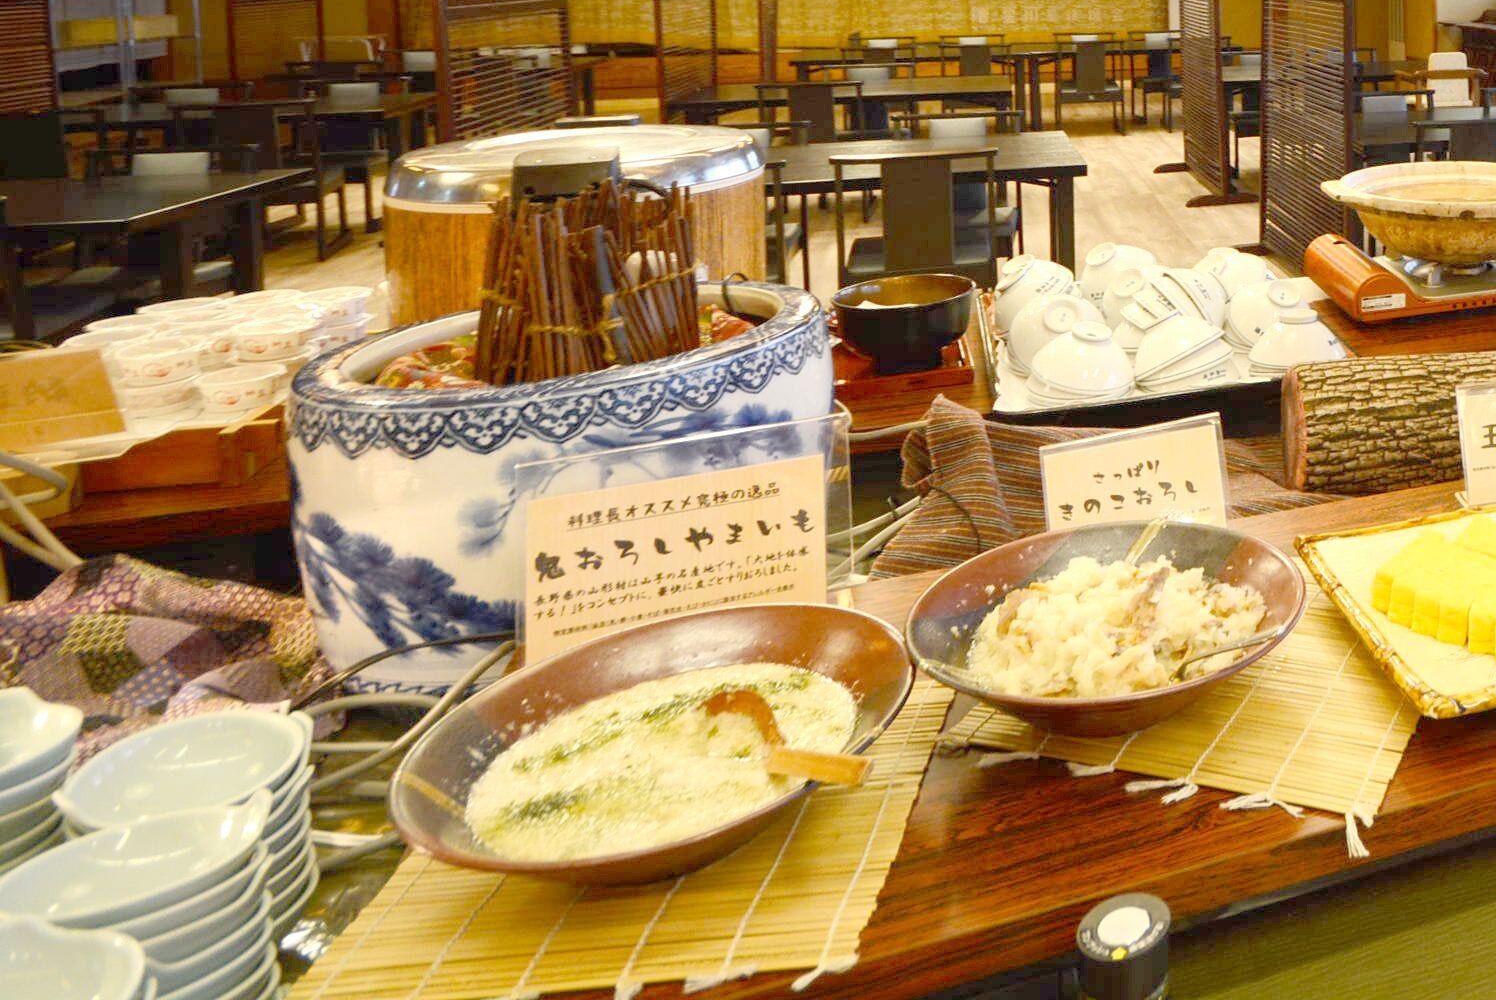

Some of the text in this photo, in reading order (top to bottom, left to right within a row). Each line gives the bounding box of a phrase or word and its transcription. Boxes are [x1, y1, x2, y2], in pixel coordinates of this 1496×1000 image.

[1092, 459, 1161, 485] さっぱり
[566, 481, 781, 529] 料理長オススメ究極の逸品
[1058, 479, 1199, 522] きのこおろし
[534, 508, 816, 583] 鬼おろしやまいも
